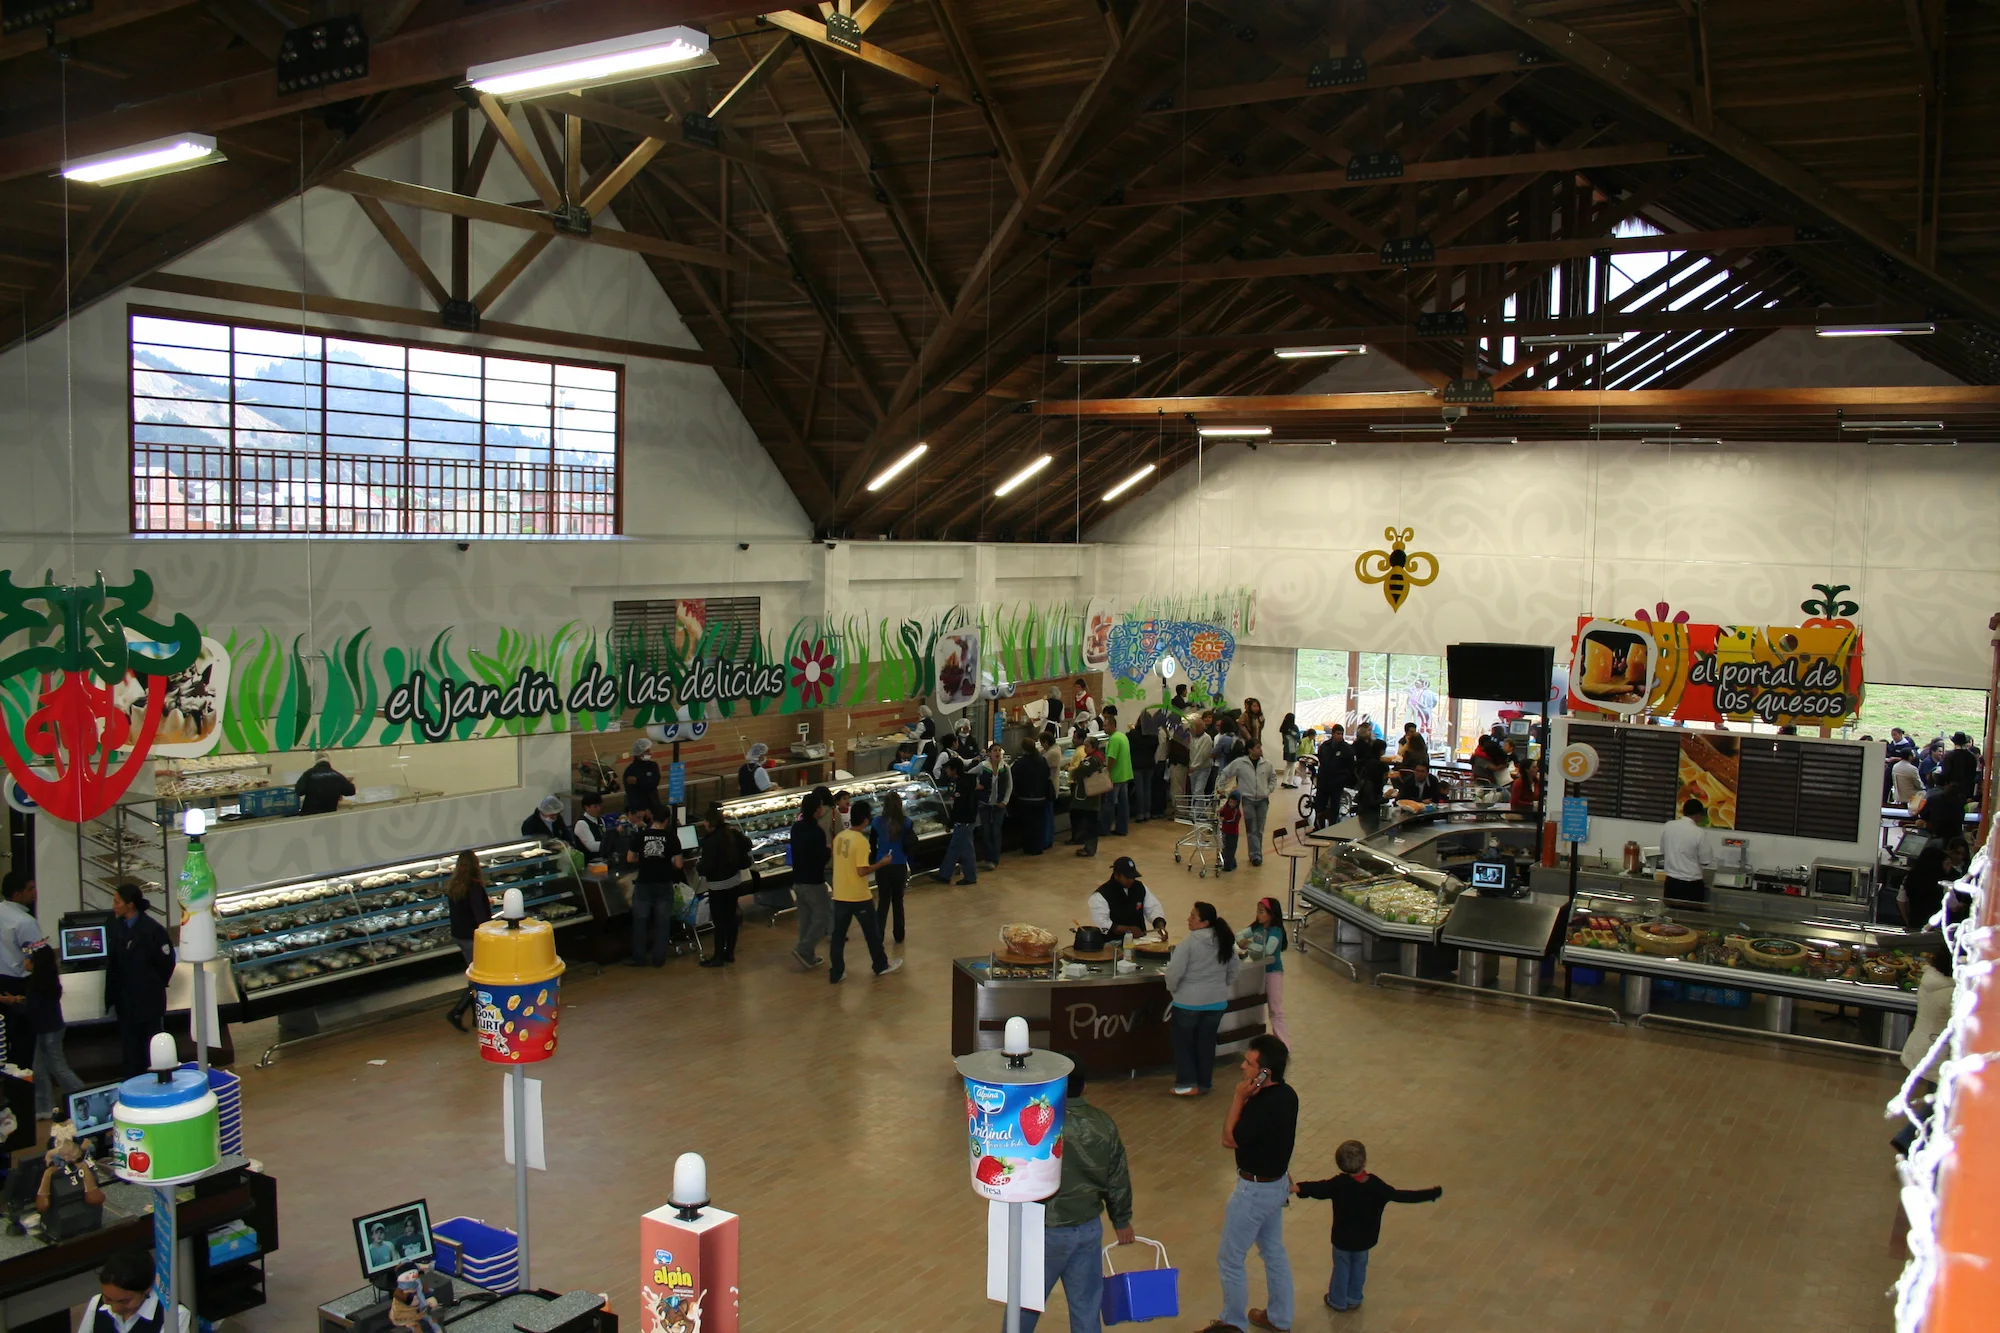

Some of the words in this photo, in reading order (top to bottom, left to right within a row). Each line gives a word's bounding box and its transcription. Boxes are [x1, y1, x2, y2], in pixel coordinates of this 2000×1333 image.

[1691, 657, 1713, 683] el
[1722, 660, 1796, 692] portal
[1804, 661, 1838, 688] de
[389, 675, 425, 720] el
[425, 671, 559, 738] jardín
[571, 666, 616, 709] de
[627, 663, 672, 704] las
[679, 659, 784, 701] delicias
[1716, 684, 1749, 710] los
[1756, 692, 1842, 720] quesos
[1567, 755, 1584, 773] 8
[478, 1019, 500, 1031] URT
[968, 1114, 1014, 1145] Original
[653, 1265, 694, 1289] alpin
